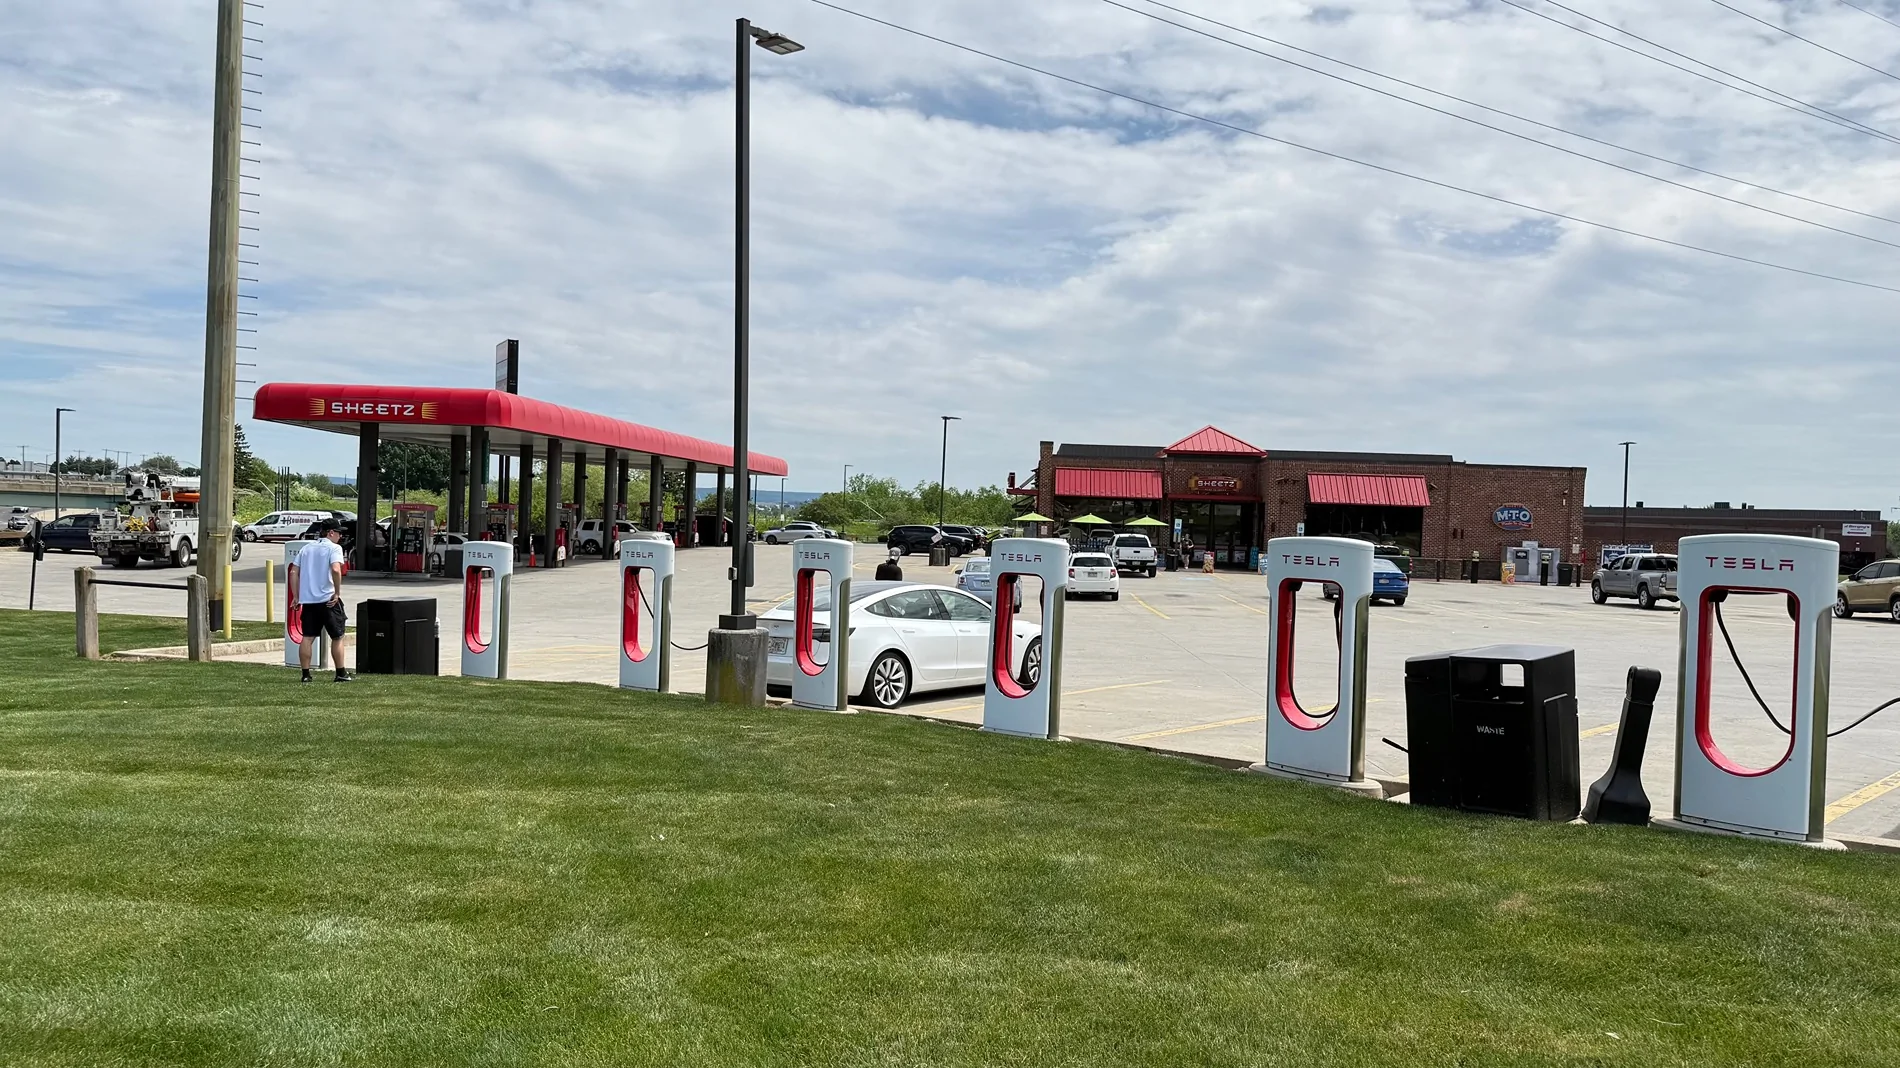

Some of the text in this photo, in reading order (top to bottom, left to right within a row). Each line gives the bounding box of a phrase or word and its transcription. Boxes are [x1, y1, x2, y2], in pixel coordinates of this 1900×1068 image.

[331, 402, 415, 416] SHEETZ
[1197, 480, 1235, 488] SHEETZ
[468, 551, 494, 559] TESLA
[625, 550, 654, 559] TESLA
[798, 551, 831, 560] TESLA
[1001, 553, 1042, 563] TESLA
[1282, 554, 1340, 567] TESLA
[1705, 556, 1794, 571] TESLA
[1476, 725, 1505, 735] WASTE
